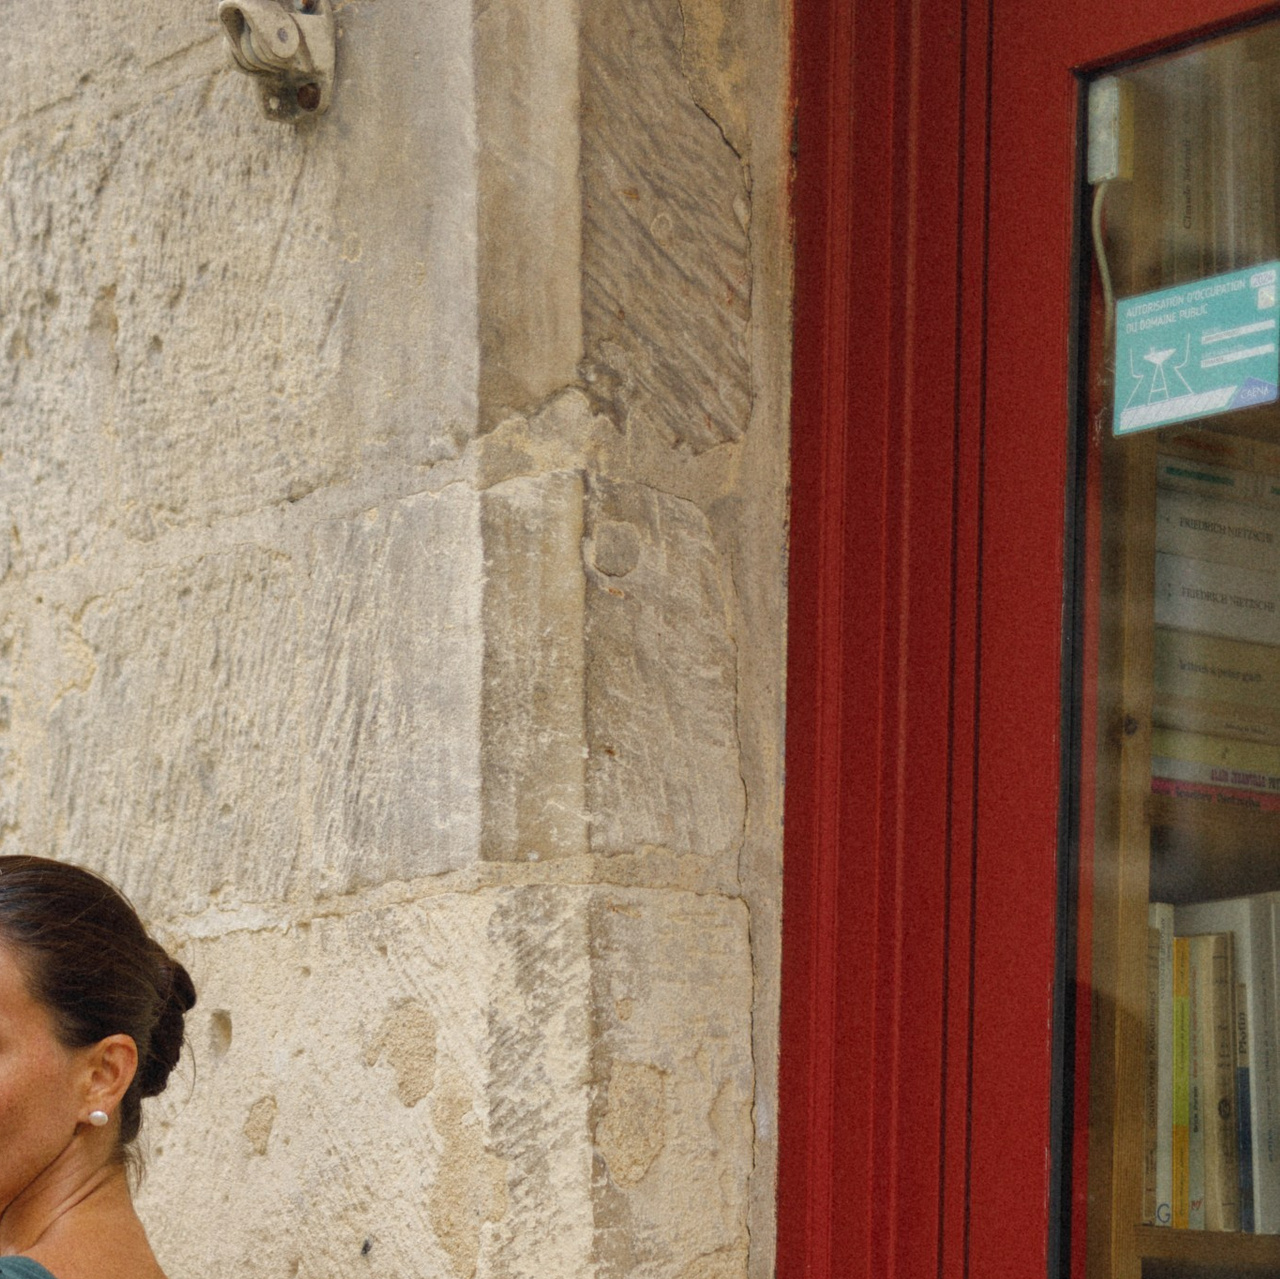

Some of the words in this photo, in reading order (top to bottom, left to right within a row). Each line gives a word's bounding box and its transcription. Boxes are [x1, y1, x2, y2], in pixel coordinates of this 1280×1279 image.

[1126, 295, 1184, 318] AUTORISATION
[1126, 322, 1138, 334] DU
[1139, 312, 1177, 330] DOMAINE
[1179, 303, 1208, 319] PUBLIC
